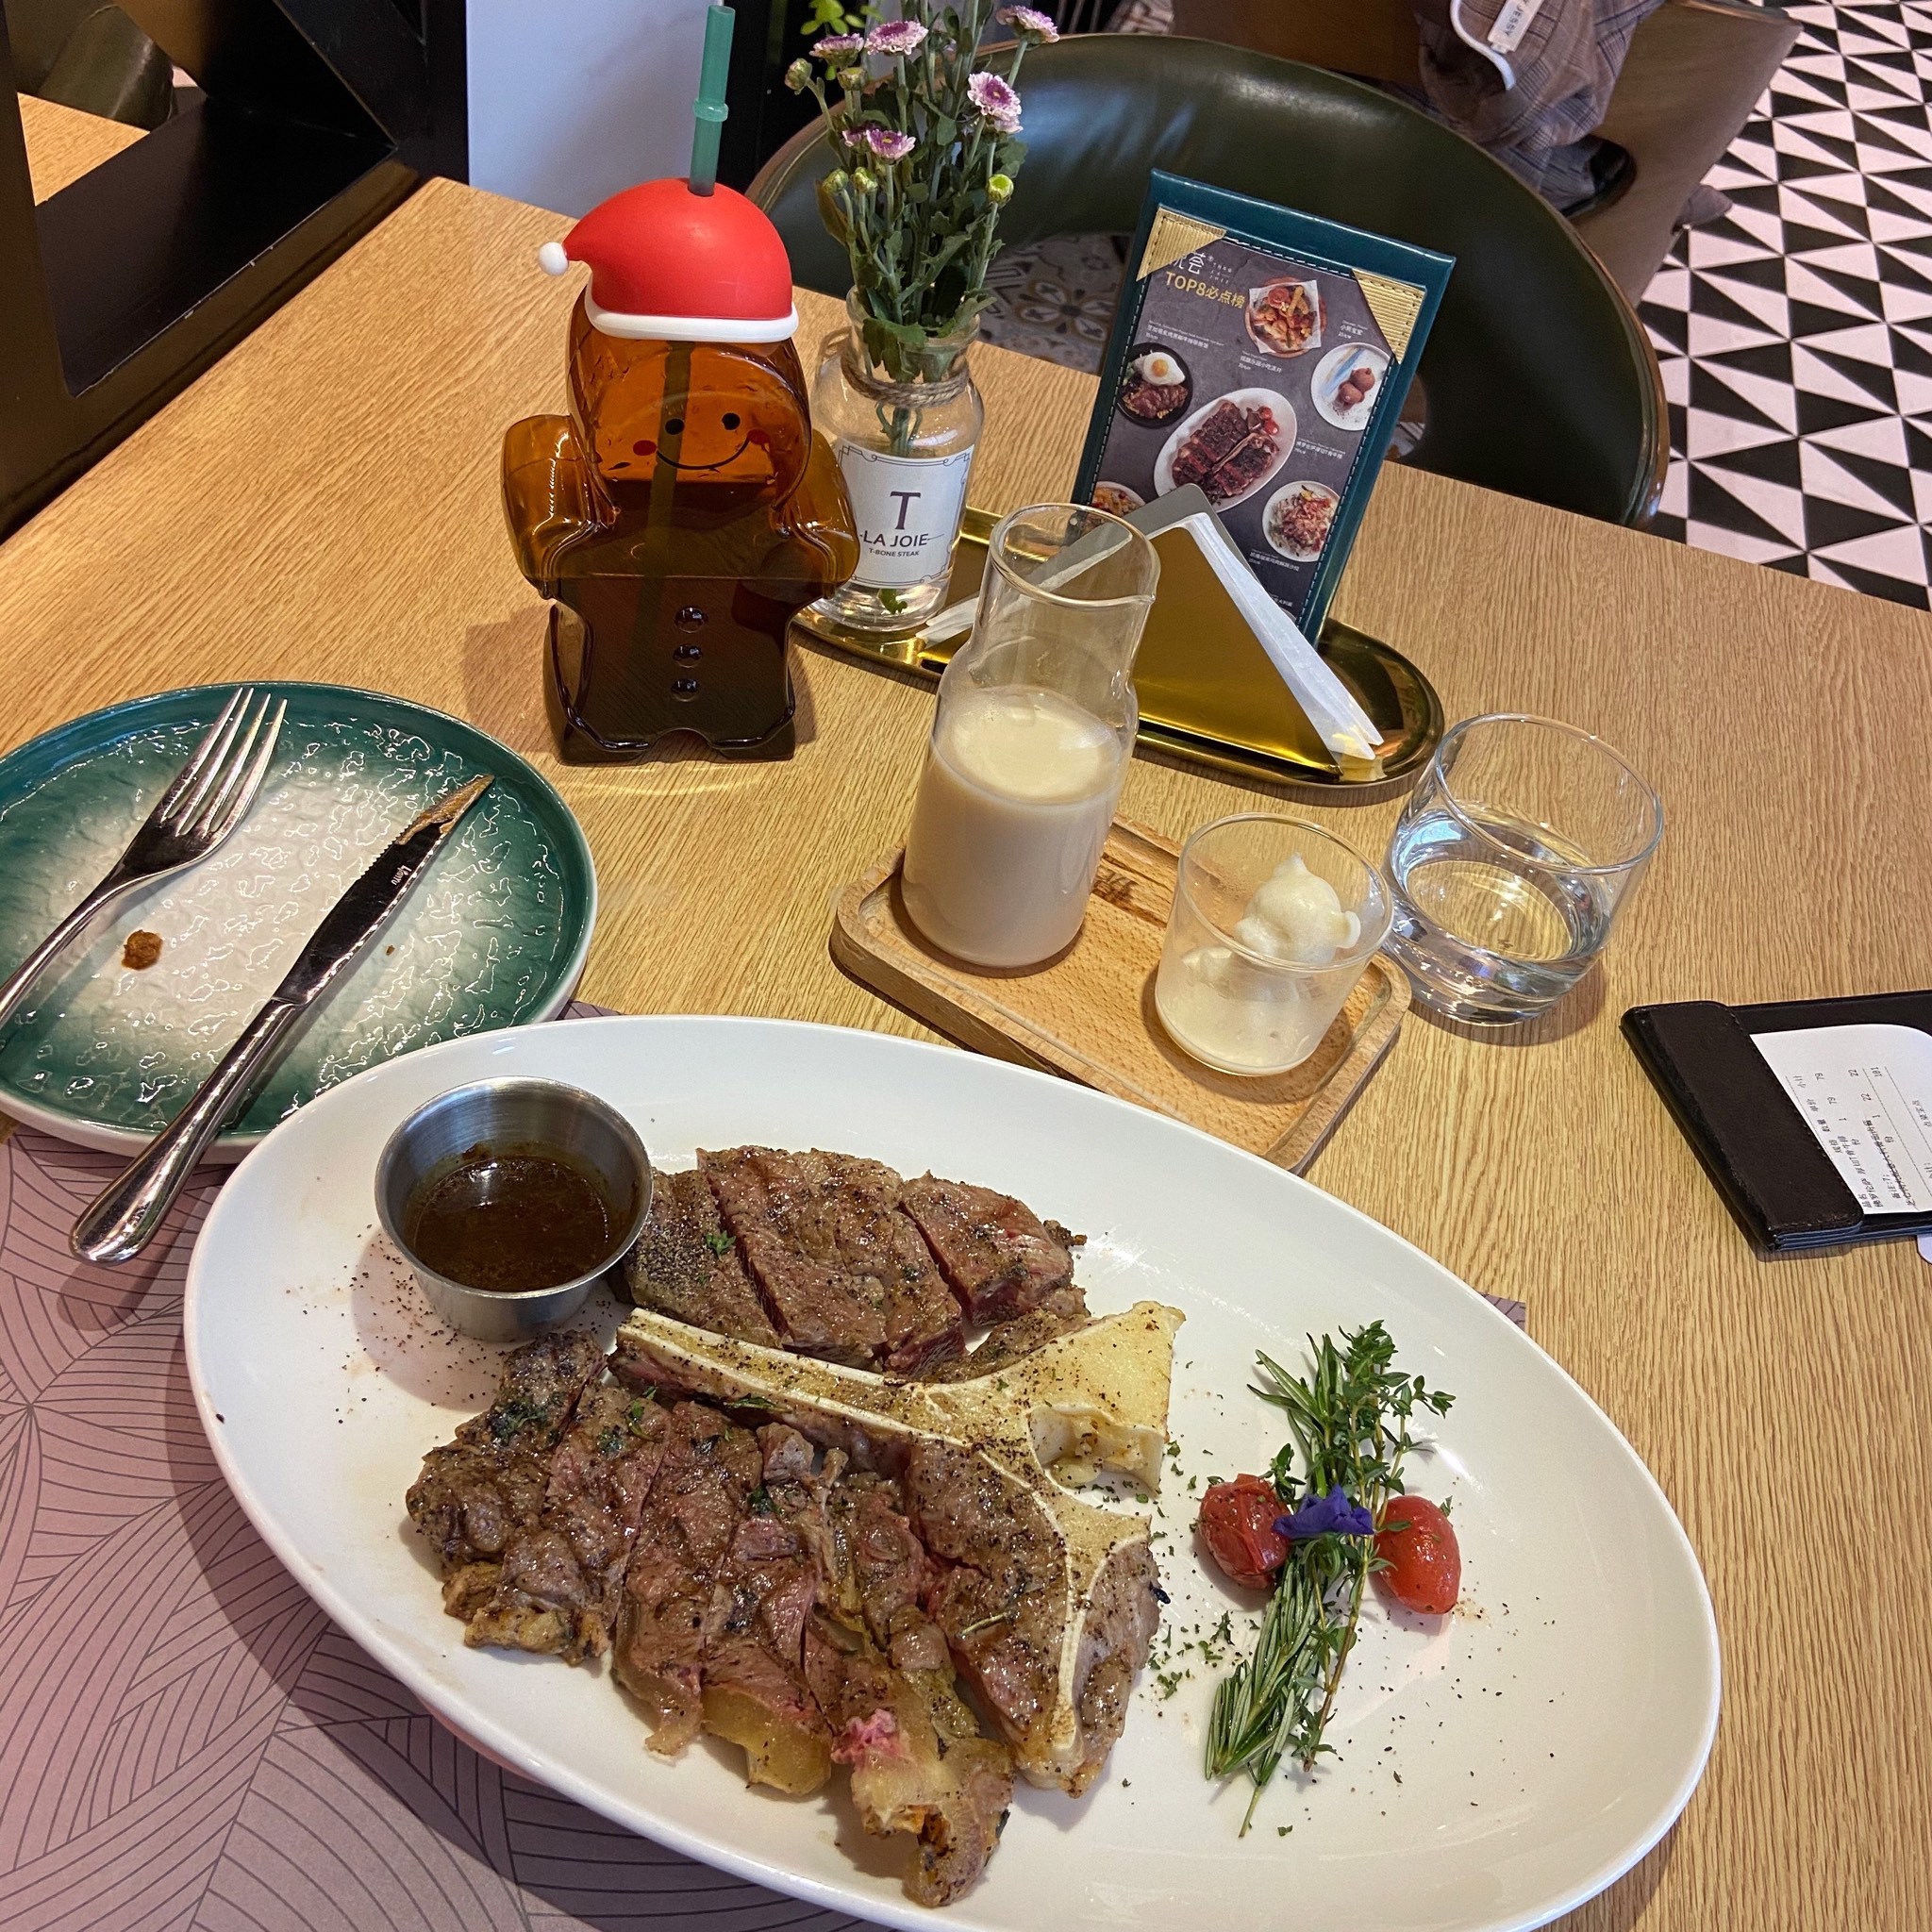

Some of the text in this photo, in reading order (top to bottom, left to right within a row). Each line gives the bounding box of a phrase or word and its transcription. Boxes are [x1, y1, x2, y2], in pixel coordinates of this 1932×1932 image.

[1165, 271, 1245, 308] TOP8必点榜
[890, 491, 921, 530] T
[863, 530, 929, 548] LA JOIE
[869, 547, 897, 557] T-BONE
[1848, 1068, 1859, 1076] 22
[1871, 1066, 1883, 1077] 101
[1860, 1093, 1872, 1102] 22
